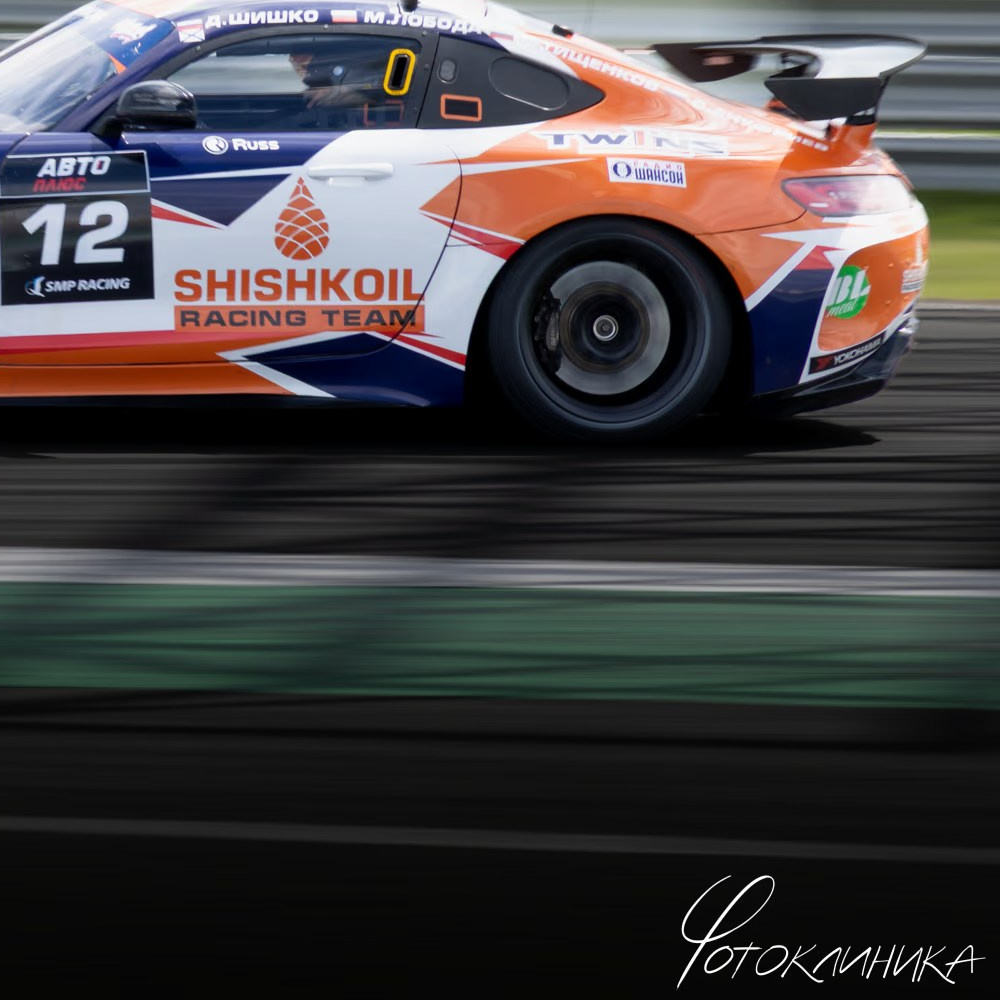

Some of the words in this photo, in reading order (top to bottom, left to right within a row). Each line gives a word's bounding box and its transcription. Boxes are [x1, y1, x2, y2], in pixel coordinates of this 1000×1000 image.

[204, 9, 319, 29] Д.ШИШКО
[231, 138, 280, 151] Russ
[36, 155, 112, 178] АВТО
[32, 177, 88, 193] ПЛЮС
[634, 168, 684, 185] ШАНСОН
[22, 200, 129, 266] 12
[44, 279, 77, 293] SMP
[77, 277, 131, 292] RACING
[174, 268, 425, 303] SHISHKOIL
[180, 309, 306, 327] RACING
[322, 309, 416, 327] TEAM
